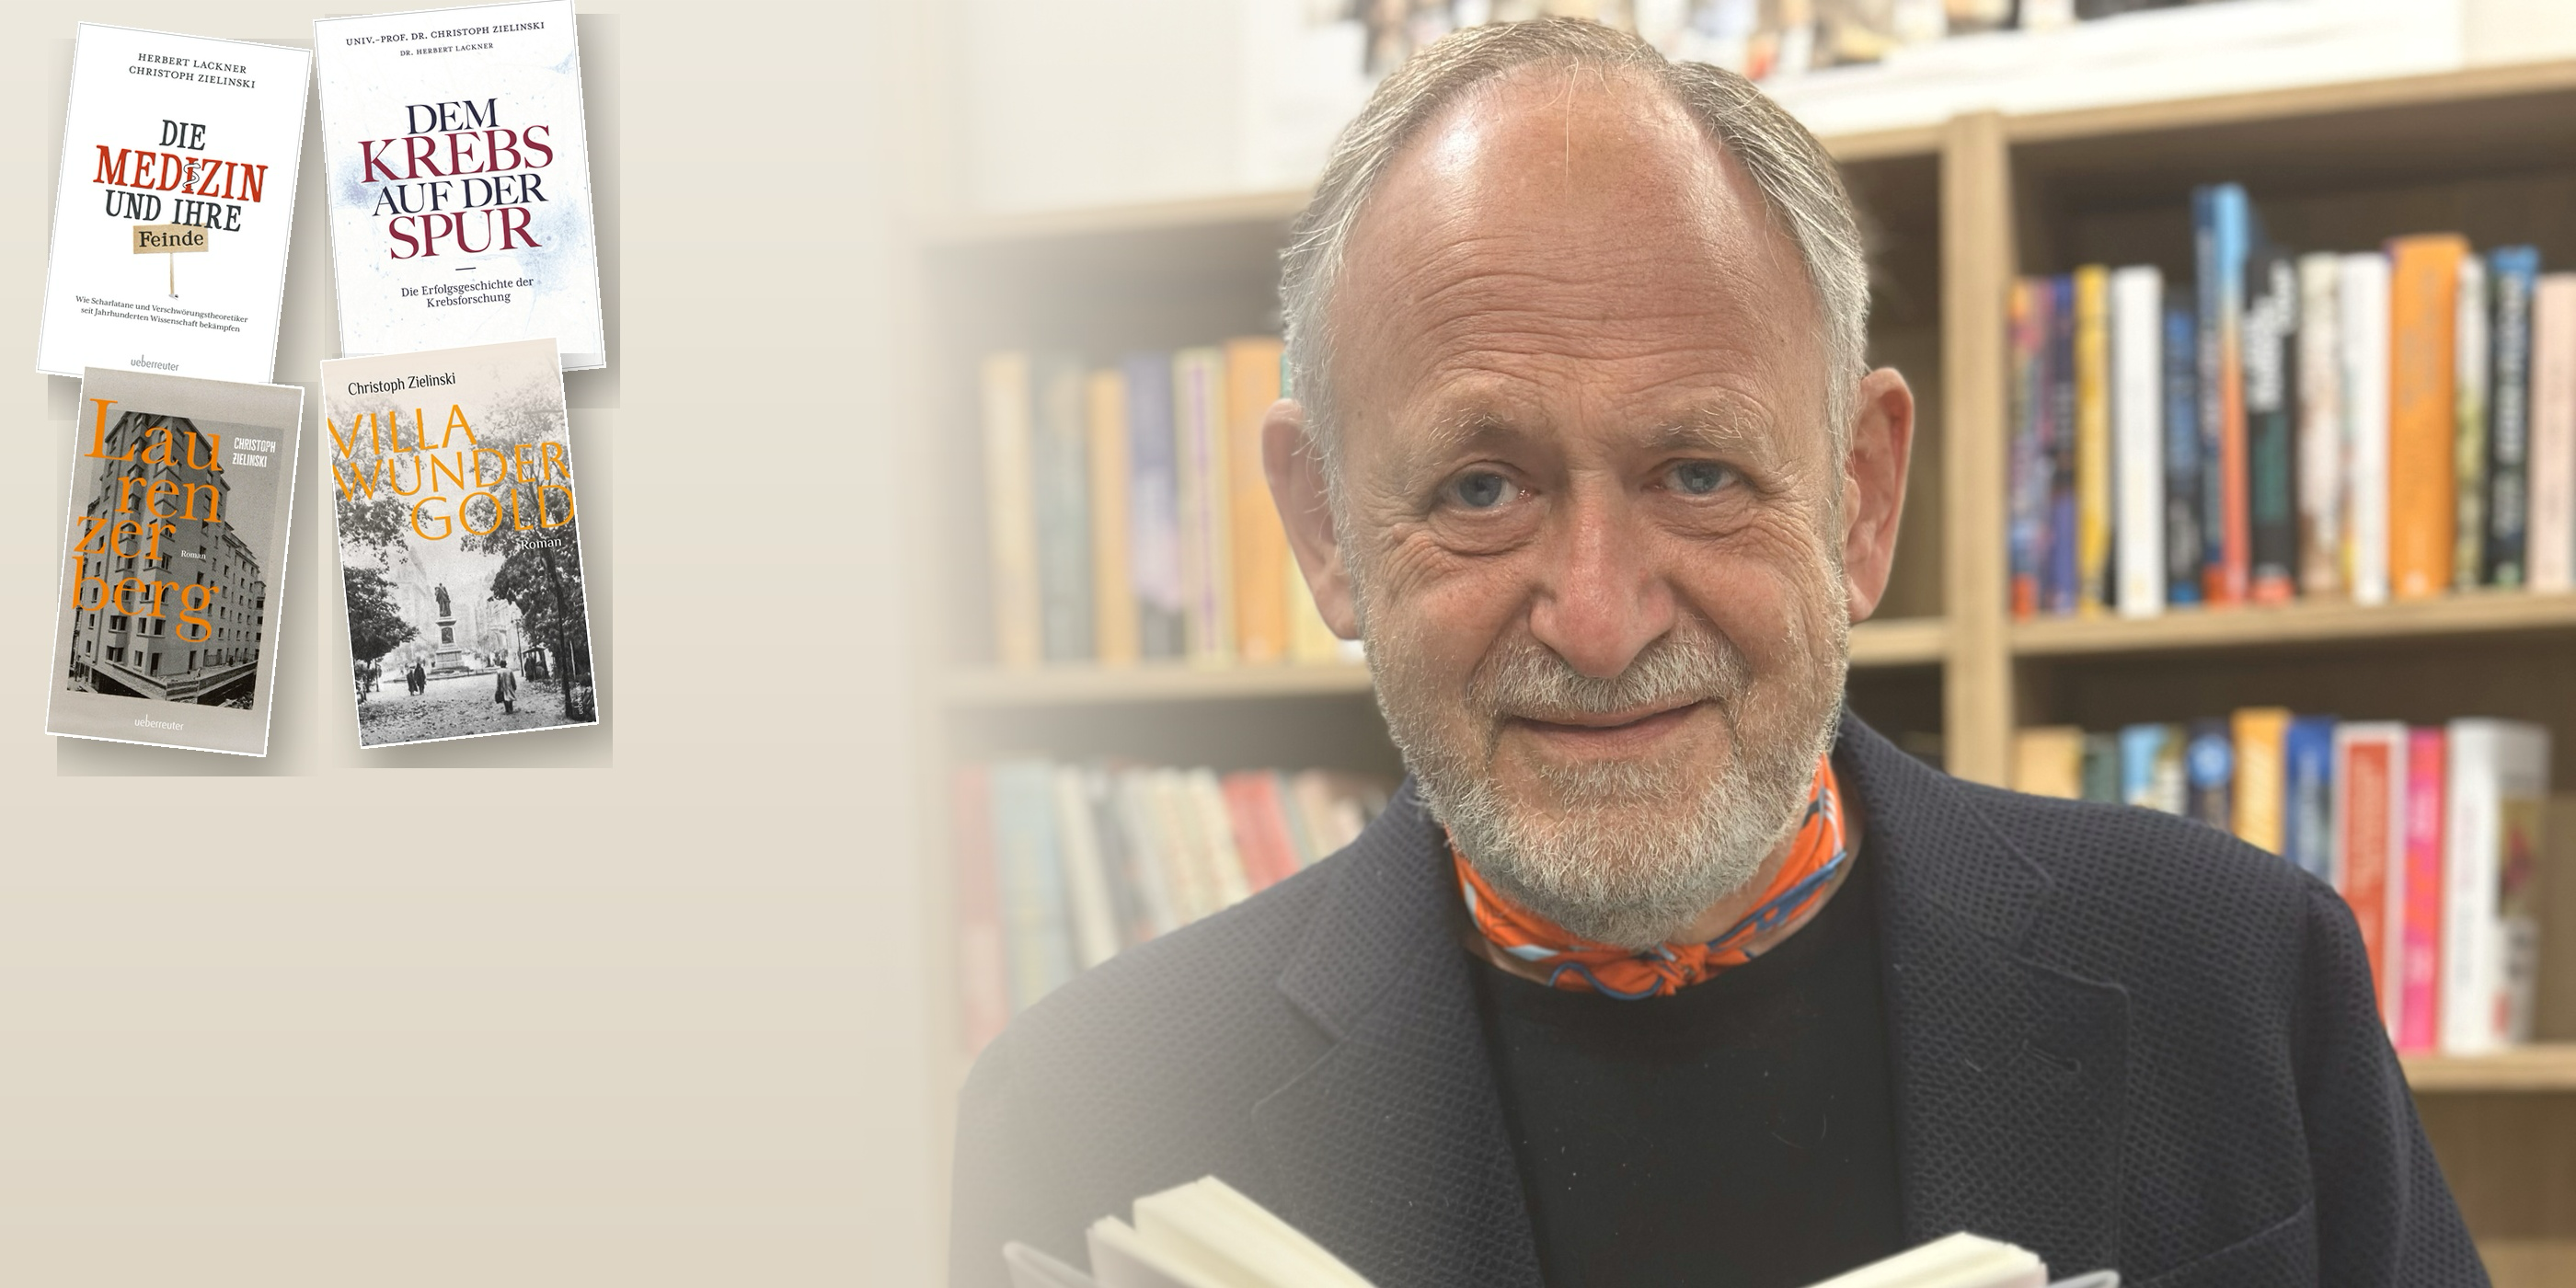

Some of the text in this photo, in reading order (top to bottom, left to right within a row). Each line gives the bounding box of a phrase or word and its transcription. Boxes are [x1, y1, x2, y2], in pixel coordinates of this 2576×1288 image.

[346, 21, 545, 46] UNIV.-PROF. DR. CHRISTOPH ZIELINSKI
[416, 46, 453, 55] HERBERT
[455, 42, 494, 52] LACKNER
[129, 65, 256, 88] CHRISTOPH ZIELINSKI
[138, 52, 247, 74] HERBERT LACKNER
[405, 98, 500, 135] DEM
[159, 120, 206, 151] DIE
[358, 124, 554, 184] KREBS
[93, 144, 268, 202] MEDIZIN
[373, 173, 548, 216] AUF DER
[105, 190, 242, 232] UND IHRE
[138, 229, 204, 248] Feinde
[388, 206, 542, 260] SPUR
[401, 277, 534, 297] Die Erfolgsgeschichte der
[427, 293, 511, 308] Krebsforschung
[75, 295, 90, 304] Wie
[91, 297, 134, 309] Scharlatane
[152, 305, 248, 323] Verschwörungstheoretiker
[94, 308, 149, 321] Jahrhunderten
[150, 315, 198, 327] Wissenschaft
[199, 321, 240, 333] bekämpfen
[131, 354, 179, 372] ueberreuter
[348, 373, 456, 396] Christoph Zielinski
[84, 398, 223, 472] Lau
[234, 437, 276, 453] CHRISTOPH
[328, 404, 477, 459] VILLA
[332, 442, 570, 502] WUNDER
[115, 473, 222, 523] ren
[411, 485, 575, 541] GOLD
[73, 515, 176, 561] zer
[521, 538, 562, 551] Roman
[180, 550, 206, 559] Roman
[71, 556, 220, 643] berg
[134, 716, 184, 731] ueberreuter
